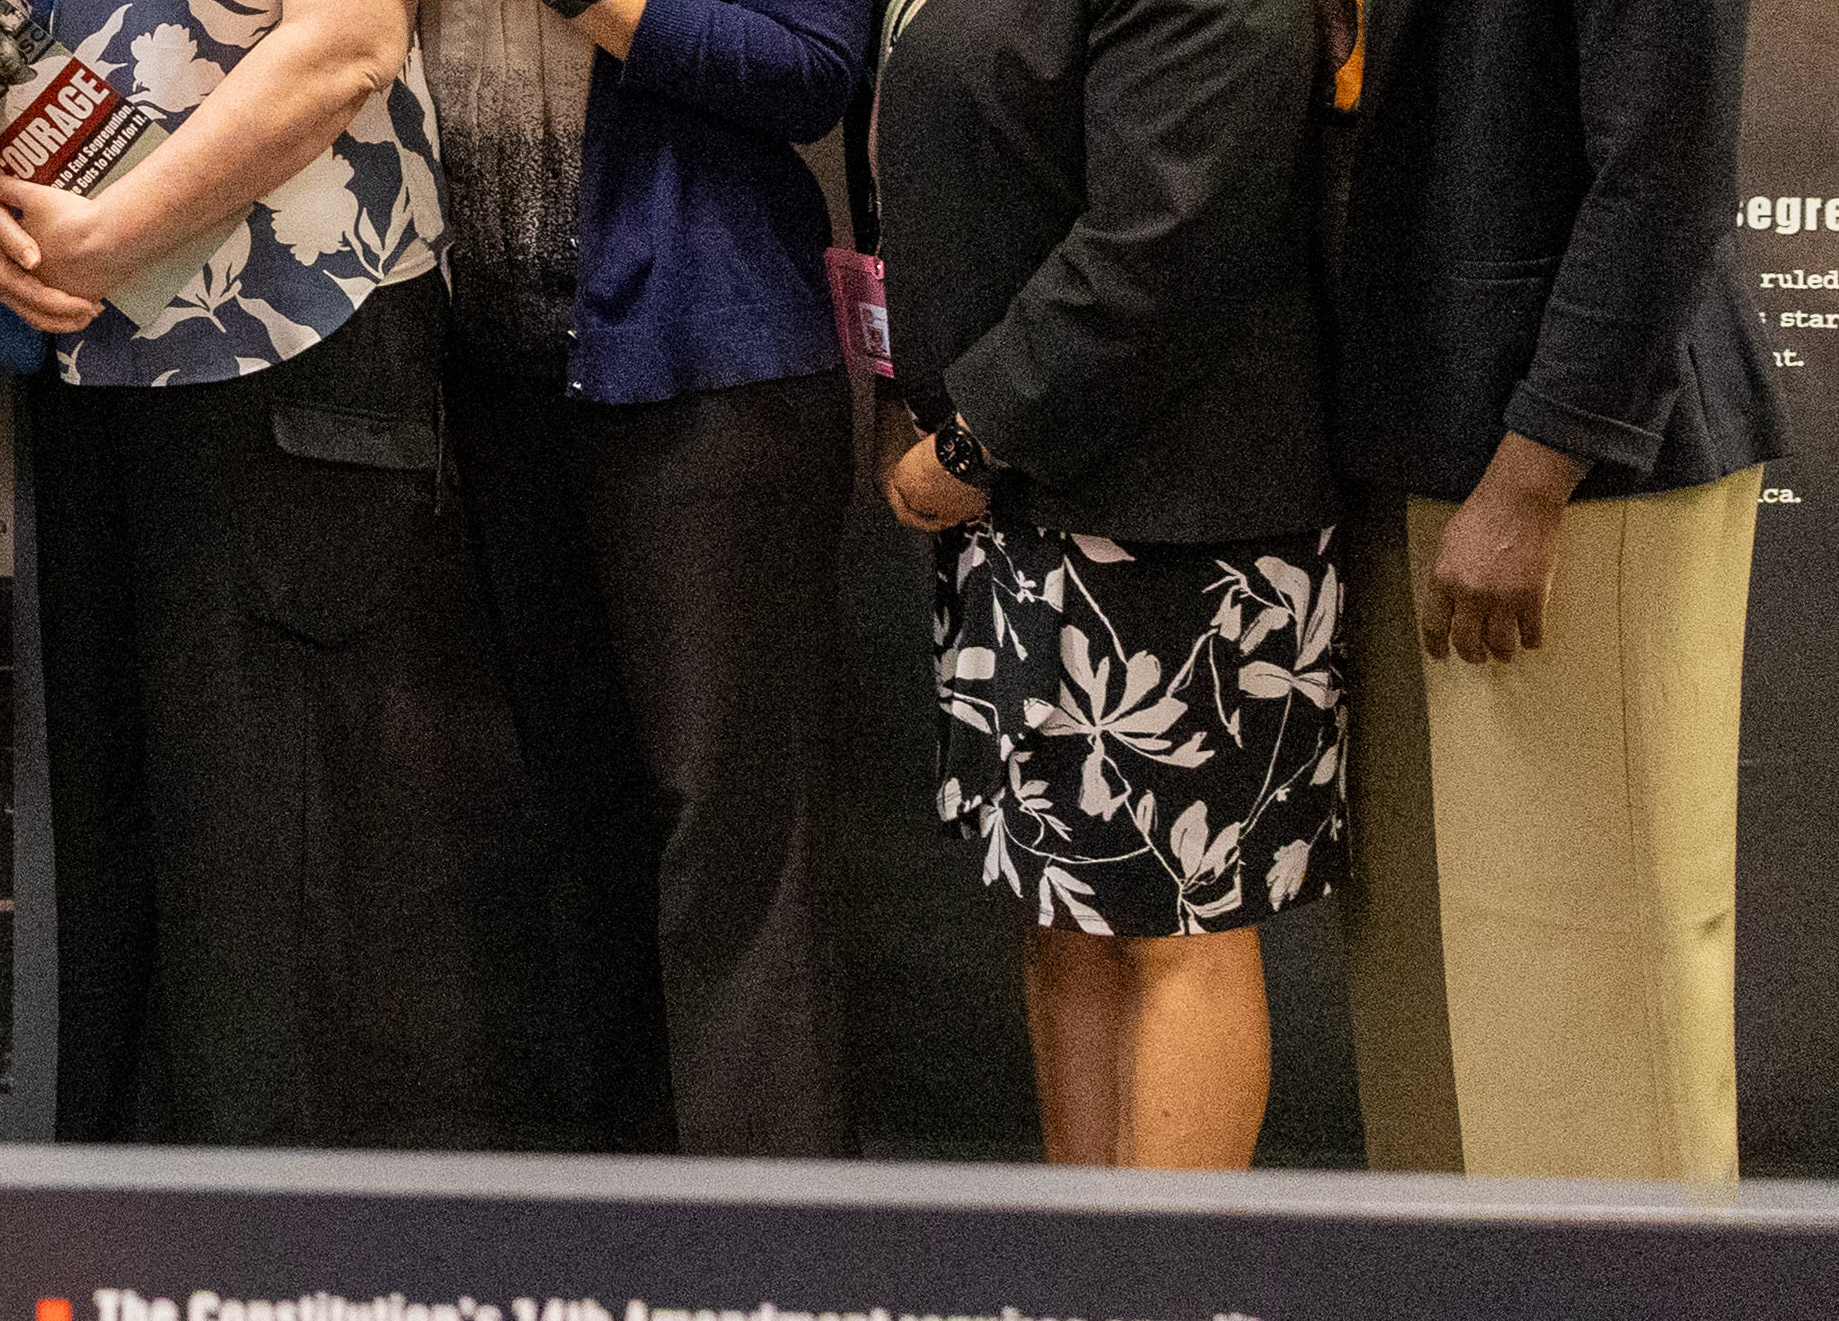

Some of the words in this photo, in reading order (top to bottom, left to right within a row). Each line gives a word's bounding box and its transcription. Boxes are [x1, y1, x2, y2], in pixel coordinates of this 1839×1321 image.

[60, 169, 73, 182] to
[68, 153, 88, 173] End
[83, 105, 135, 157] Segregation.
[76, 166, 99, 188] Guts
[94, 157, 108, 170] to
[102, 136, 127, 161] Fight
[121, 124, 138, 140] for
[133, 114, 148, 127] It.
[1737, 196, 1839, 235] egre
[1760, 269, 1839, 290] ruled
